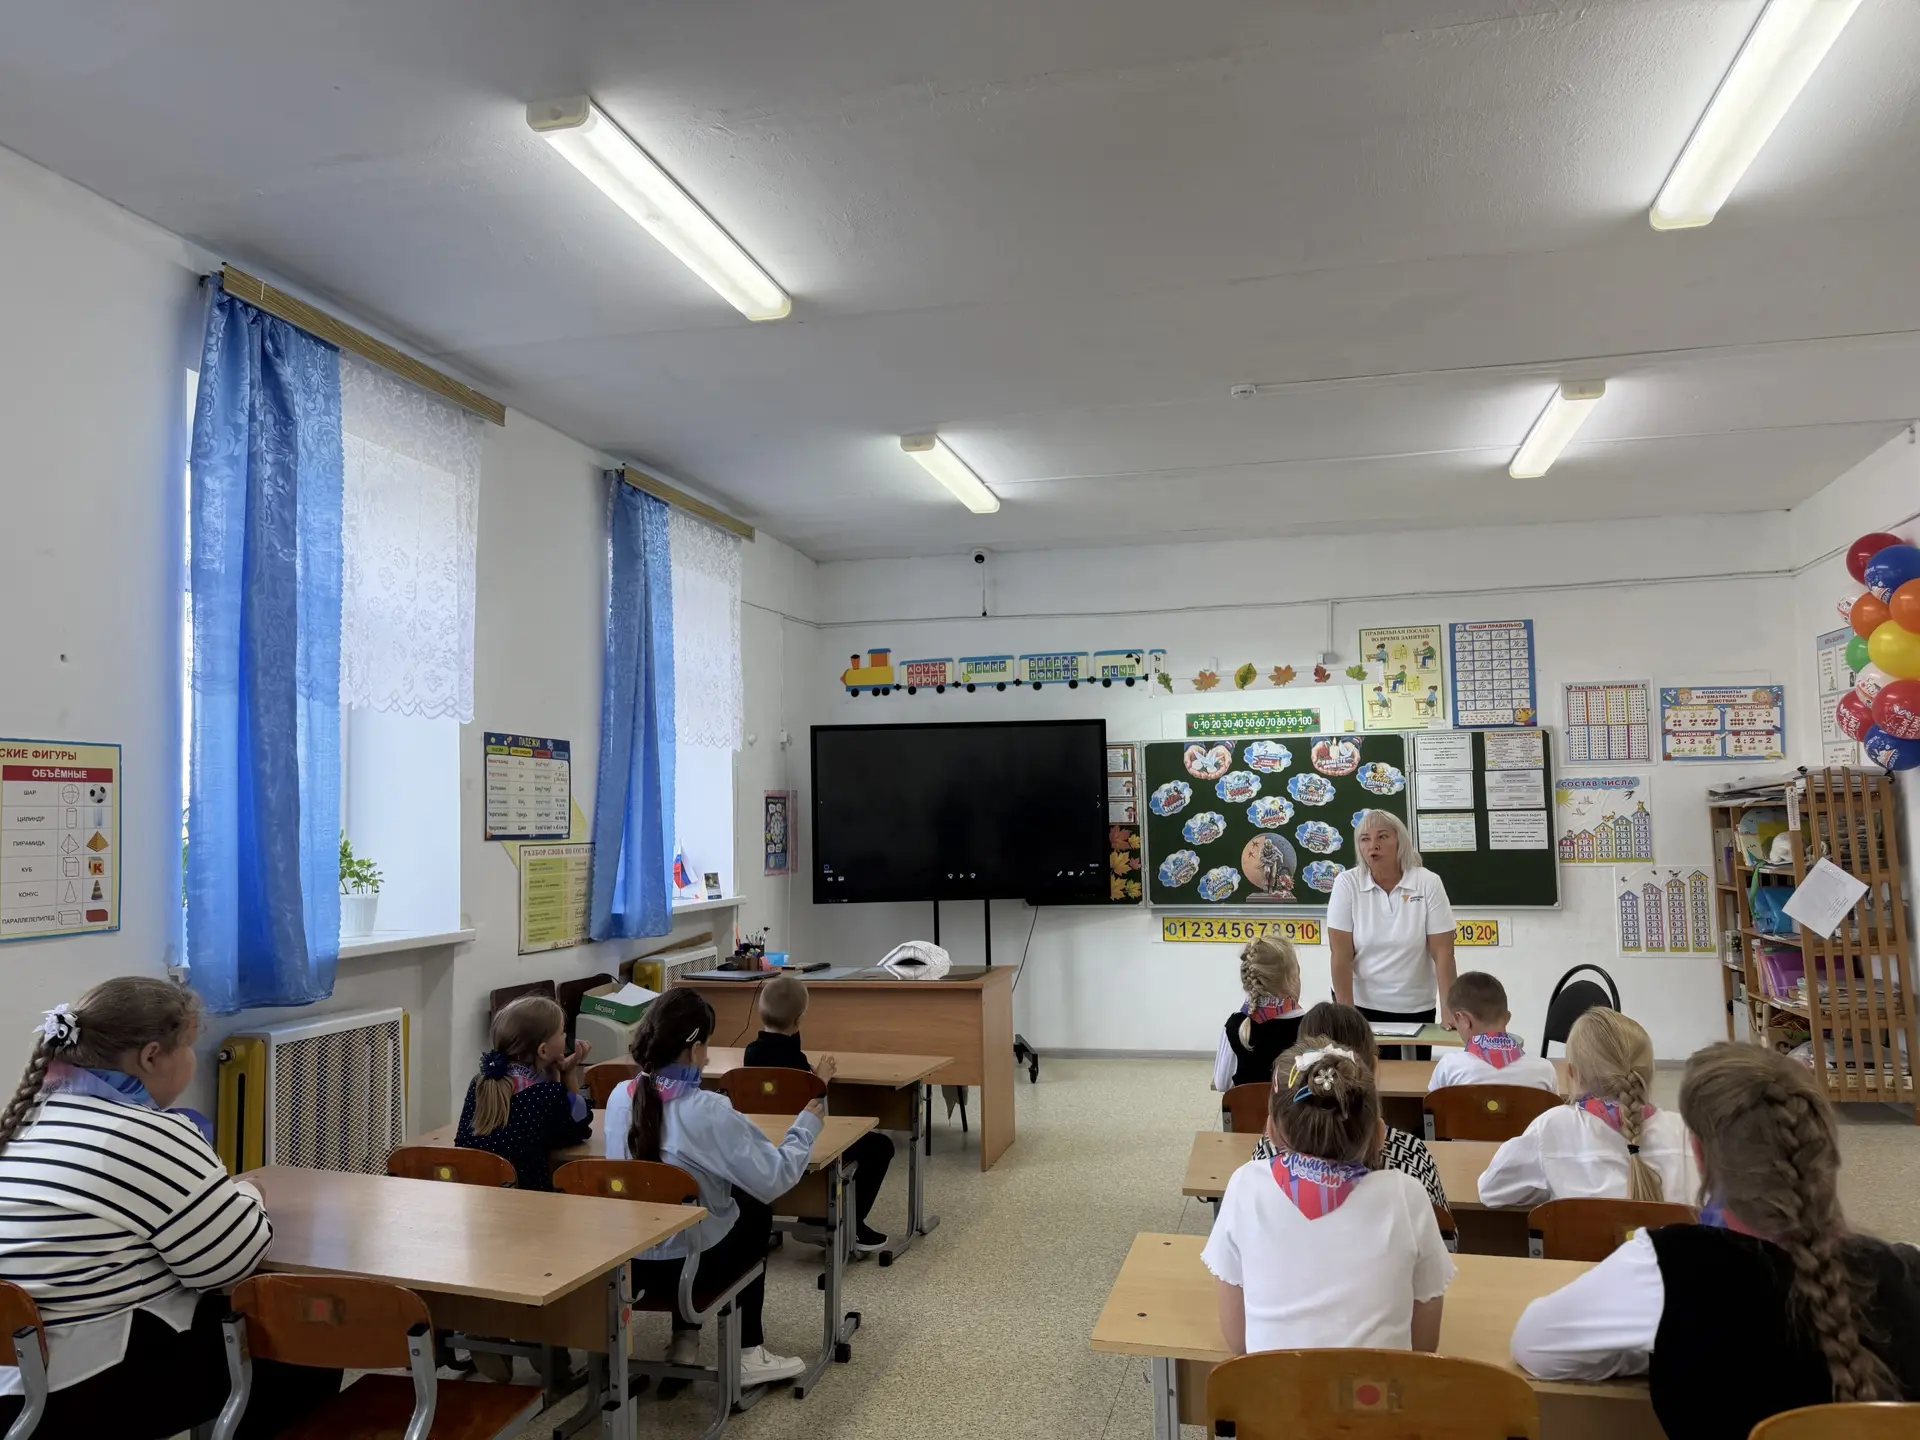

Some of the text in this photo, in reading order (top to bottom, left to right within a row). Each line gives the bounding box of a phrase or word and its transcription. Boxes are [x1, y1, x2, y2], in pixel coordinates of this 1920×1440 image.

[1212, 720, 1221, 728] 20
[1246, 719, 1254, 727] 50
[1256, 719, 1265, 727] 60
[1267, 718, 1275, 726] 70
[1277, 718, 1286, 726] 80
[1299, 716, 1312, 725] 100
[519, 737, 540, 748] ПАДЕЖИ
[0, 748, 77, 760] СКИЕ ФИГУРЫ
[32, 768, 88, 778] ОБЪЁМНЫЕ
[2, 915, 55, 925] ПАРАЛЛЕЛЕПИПЕД
[1169, 922, 1315, 939] 0 1 2 3 4 5 6 7 8 9 10
[1460, 926, 1473, 940] 19
[1477, 925, 1492, 940] 20
